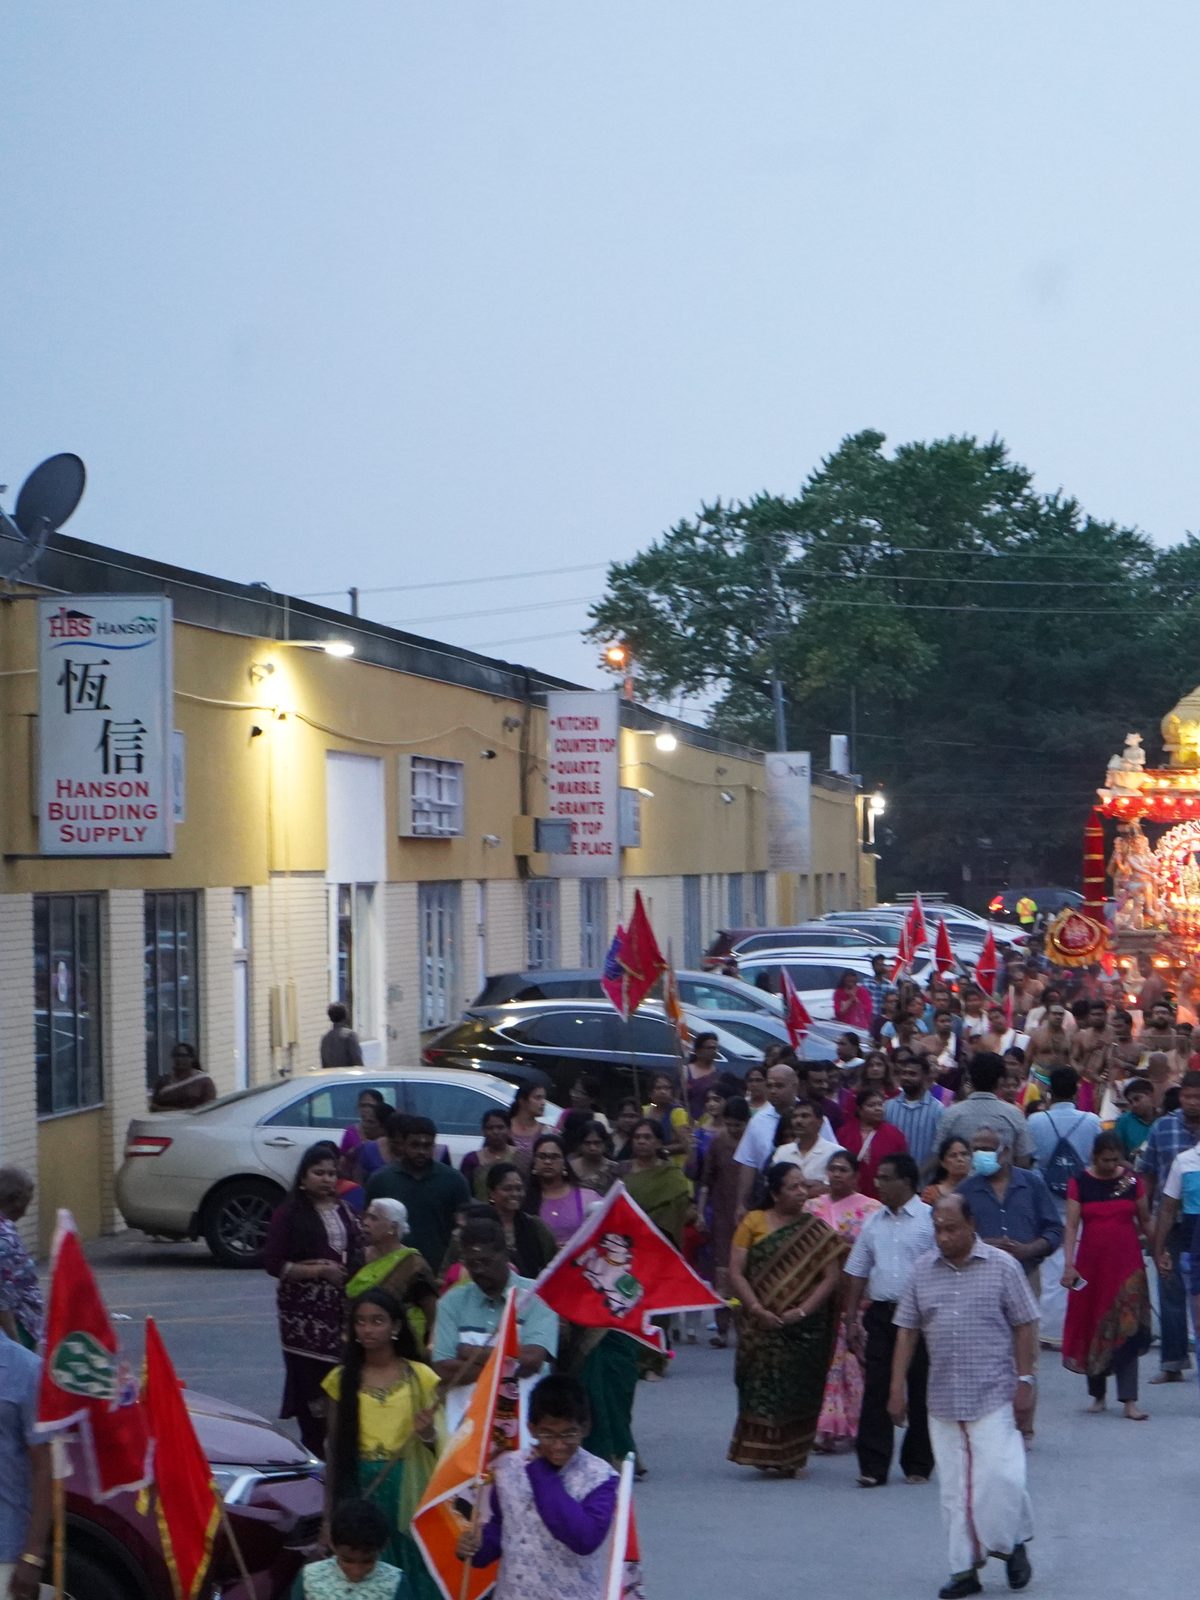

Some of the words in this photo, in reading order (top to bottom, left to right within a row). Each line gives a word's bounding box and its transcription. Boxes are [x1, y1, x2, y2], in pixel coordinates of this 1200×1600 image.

[49, 607, 92, 637] HBS
[97, 622, 157, 634] HANSON
[557, 716, 599, 730] KITCHEN
[555, 739, 596, 752] COUNTER
[599, 739, 615, 752] TOP
[557, 761, 600, 774] QUARTZ
[56, 779, 149, 798] HANSON
[557, 781, 600, 794] MARBLE
[48, 802, 158, 820] BUILDING
[558, 802, 604, 814] GRANITE
[60, 824, 147, 842] SUPPLY
[582, 822, 602, 834] TOP
[582, 842, 612, 855] PLACE
